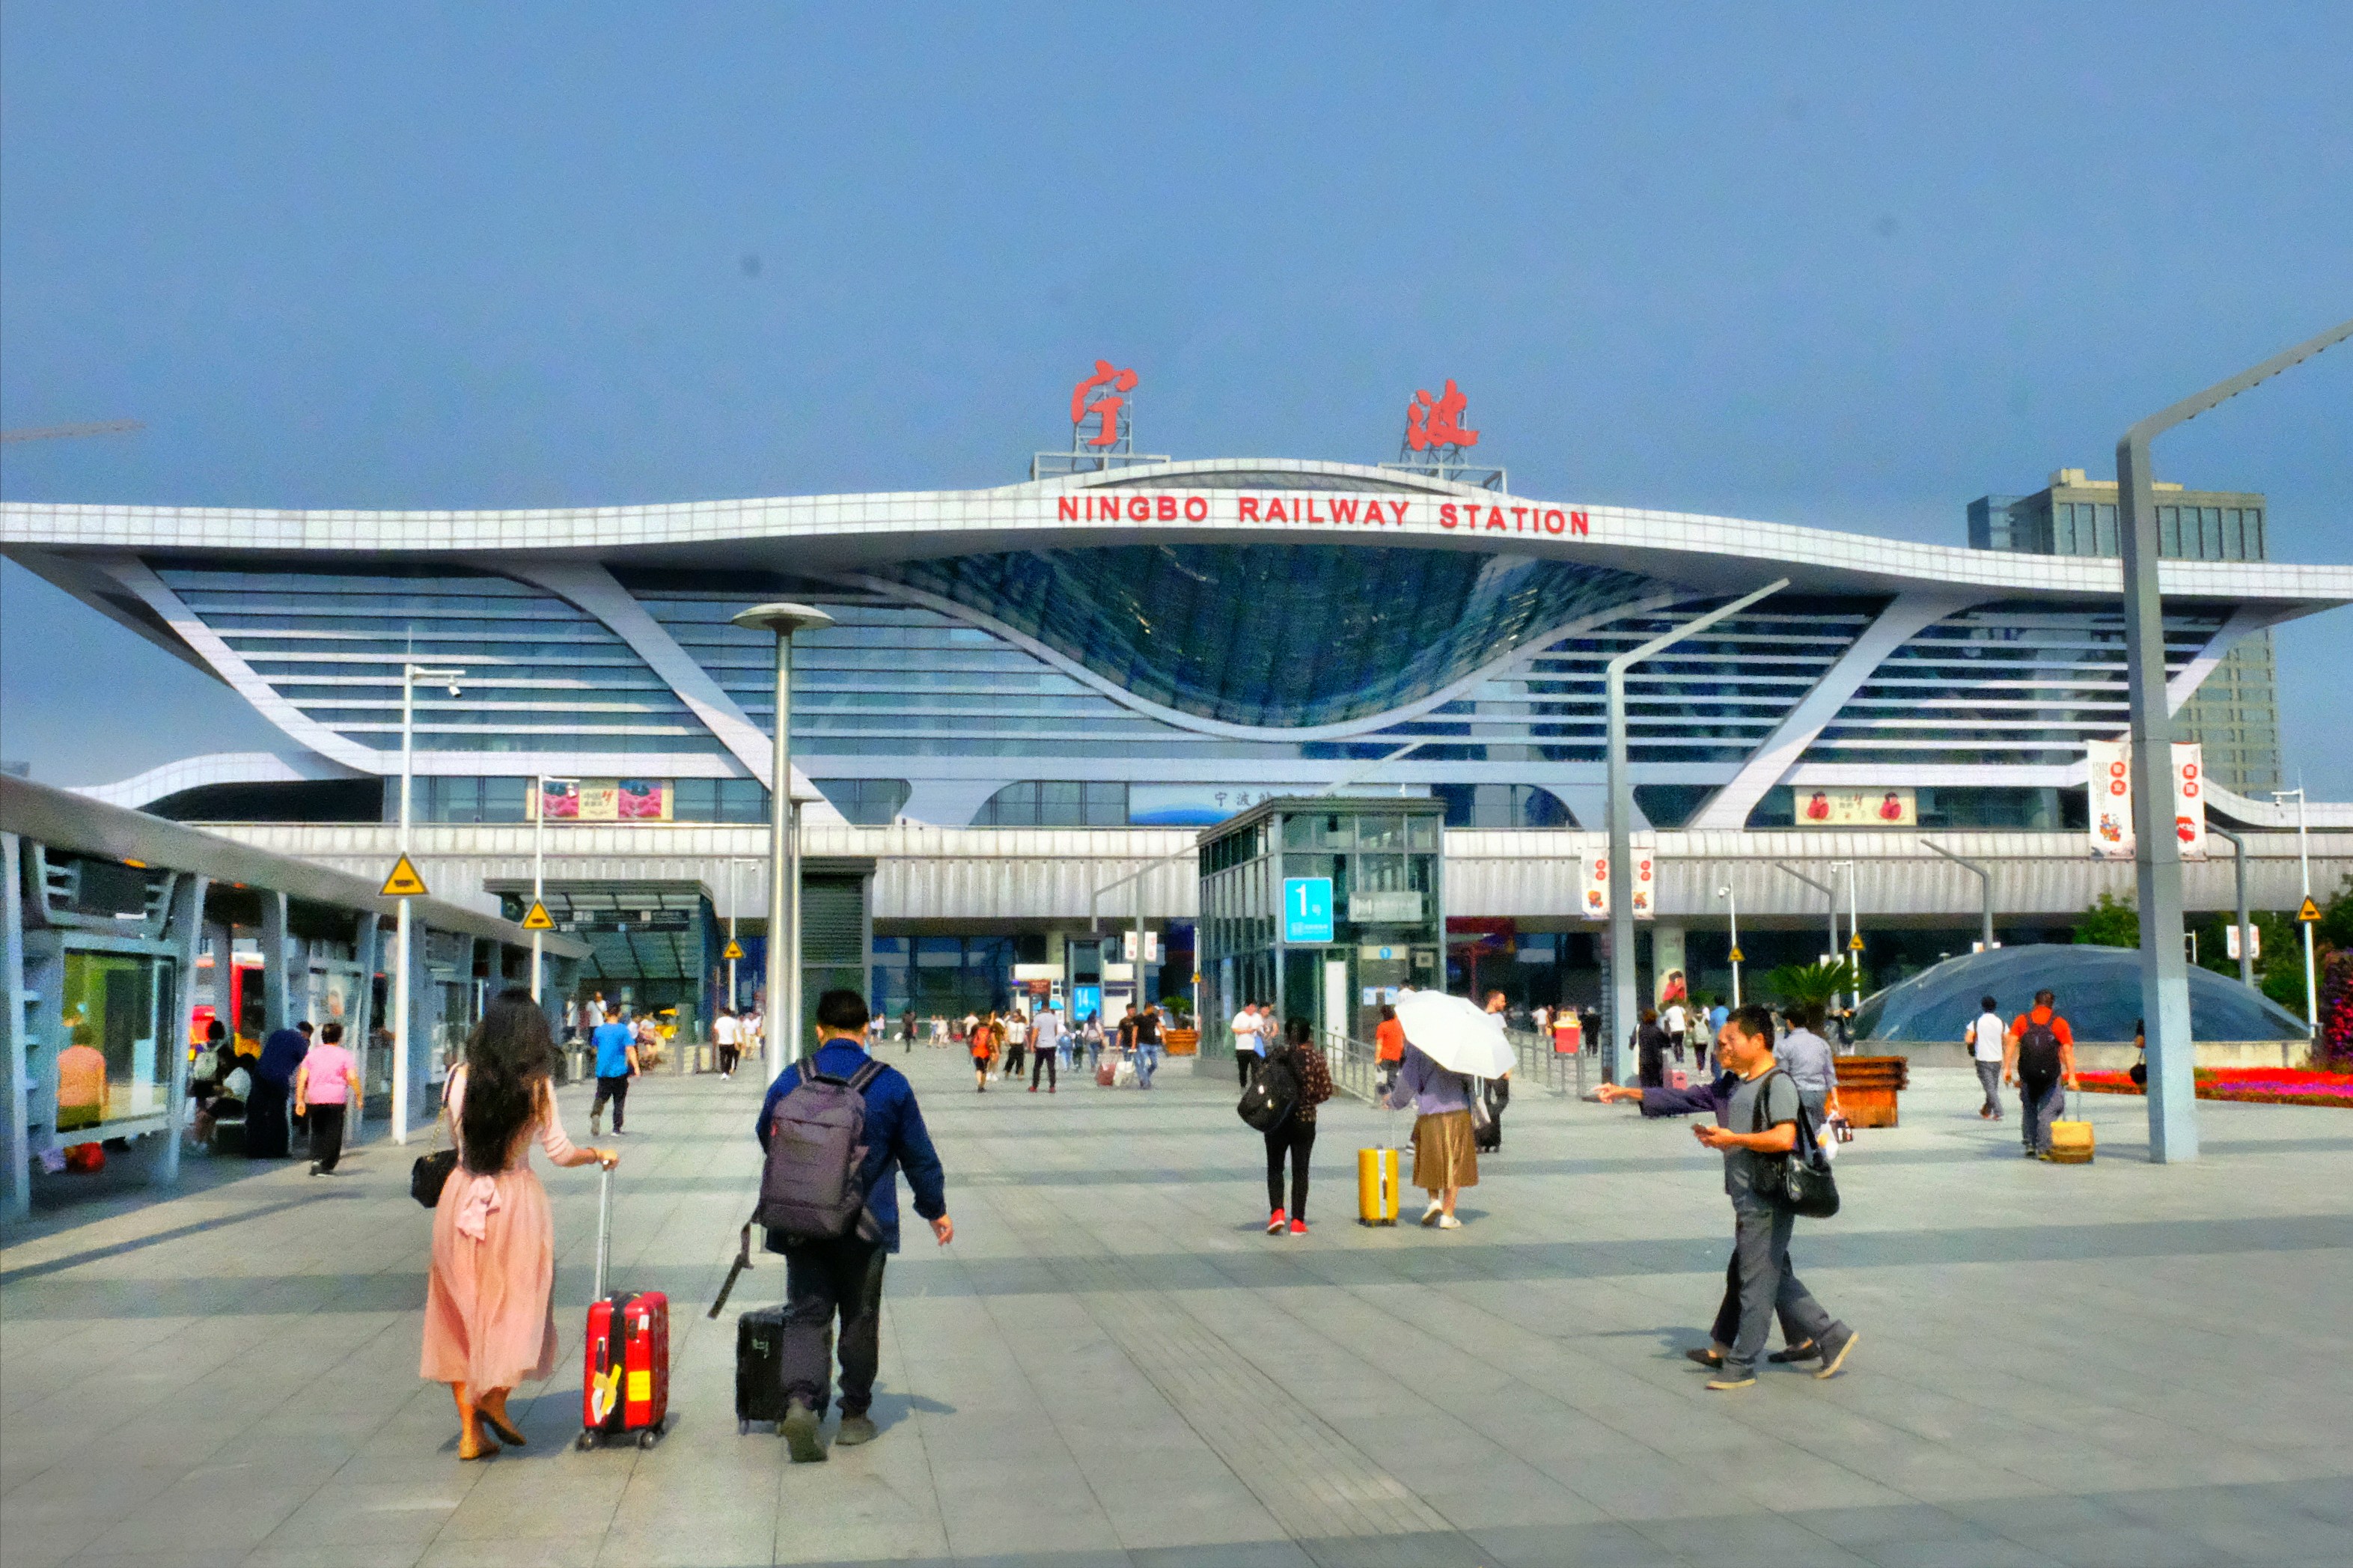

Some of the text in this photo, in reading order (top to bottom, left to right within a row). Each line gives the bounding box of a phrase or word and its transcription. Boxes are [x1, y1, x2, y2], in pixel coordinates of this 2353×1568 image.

[1058, 494, 1590, 536] NINGBO RAILWAY STATION
